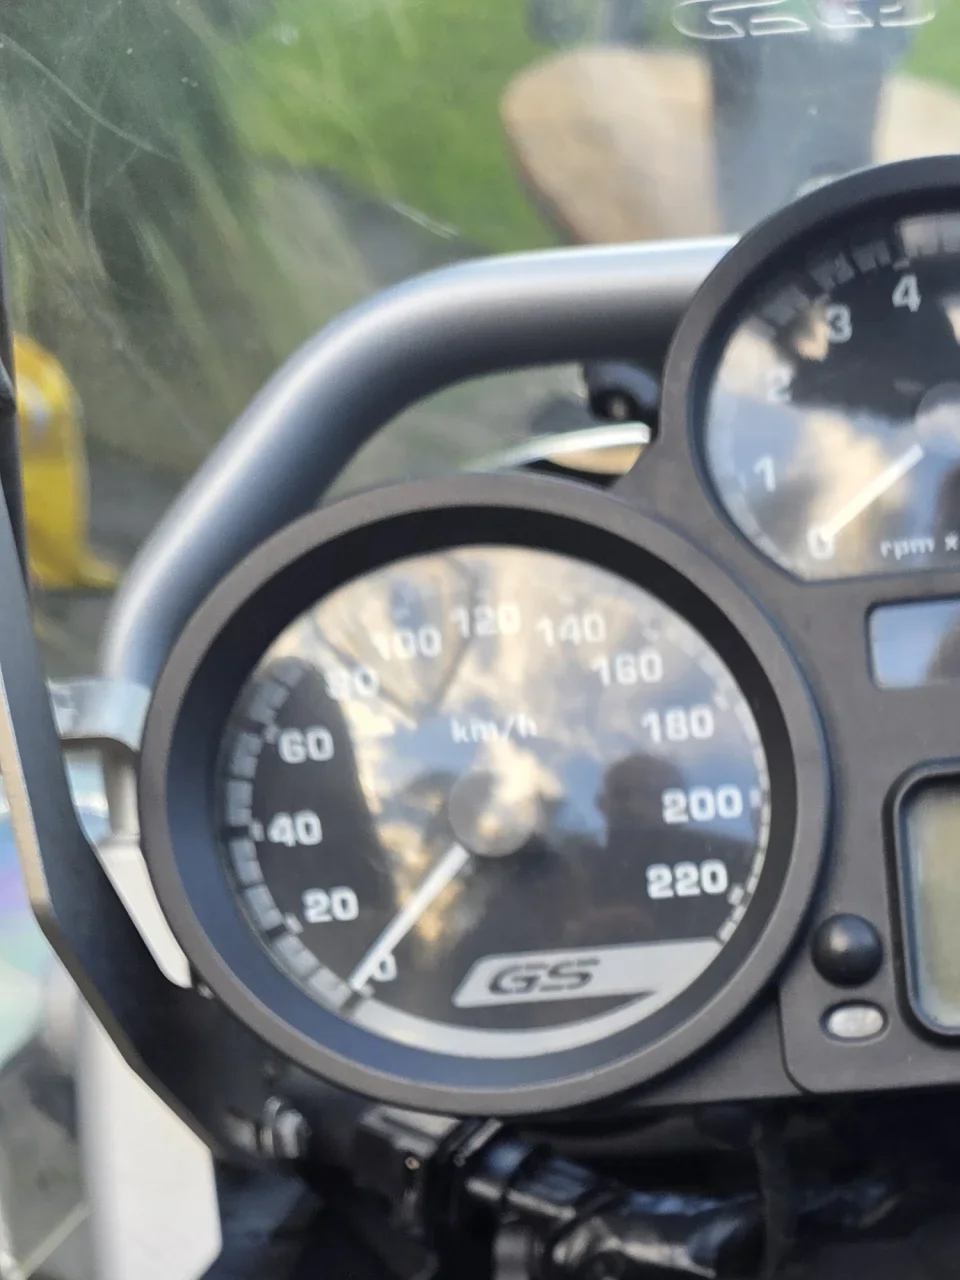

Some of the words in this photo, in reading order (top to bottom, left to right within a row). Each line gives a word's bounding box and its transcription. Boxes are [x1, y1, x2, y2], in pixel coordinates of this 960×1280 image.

[893, 275, 920, 312] 4
[829, 304, 852, 343] 3
[766, 365, 791, 403] 2
[754, 456, 776, 492] 1
[807, 525, 835, 559] 0
[880, 538, 935, 560] rpm
[945, 532, 959, 551] x
[450, 604, 521, 638] 120
[537, 612, 606, 647] 140
[373, 625, 442, 661] 100
[593, 651, 664, 687] 160
[450, 713, 538, 744] km/h
[642, 707, 715, 743] 180
[279, 726, 334, 764] 60
[661, 785, 743, 824] 200
[267, 811, 322, 847] 40
[646, 860, 728, 899] 220
[303, 886, 359, 923] 20
[488, 956, 600, 995] GS
